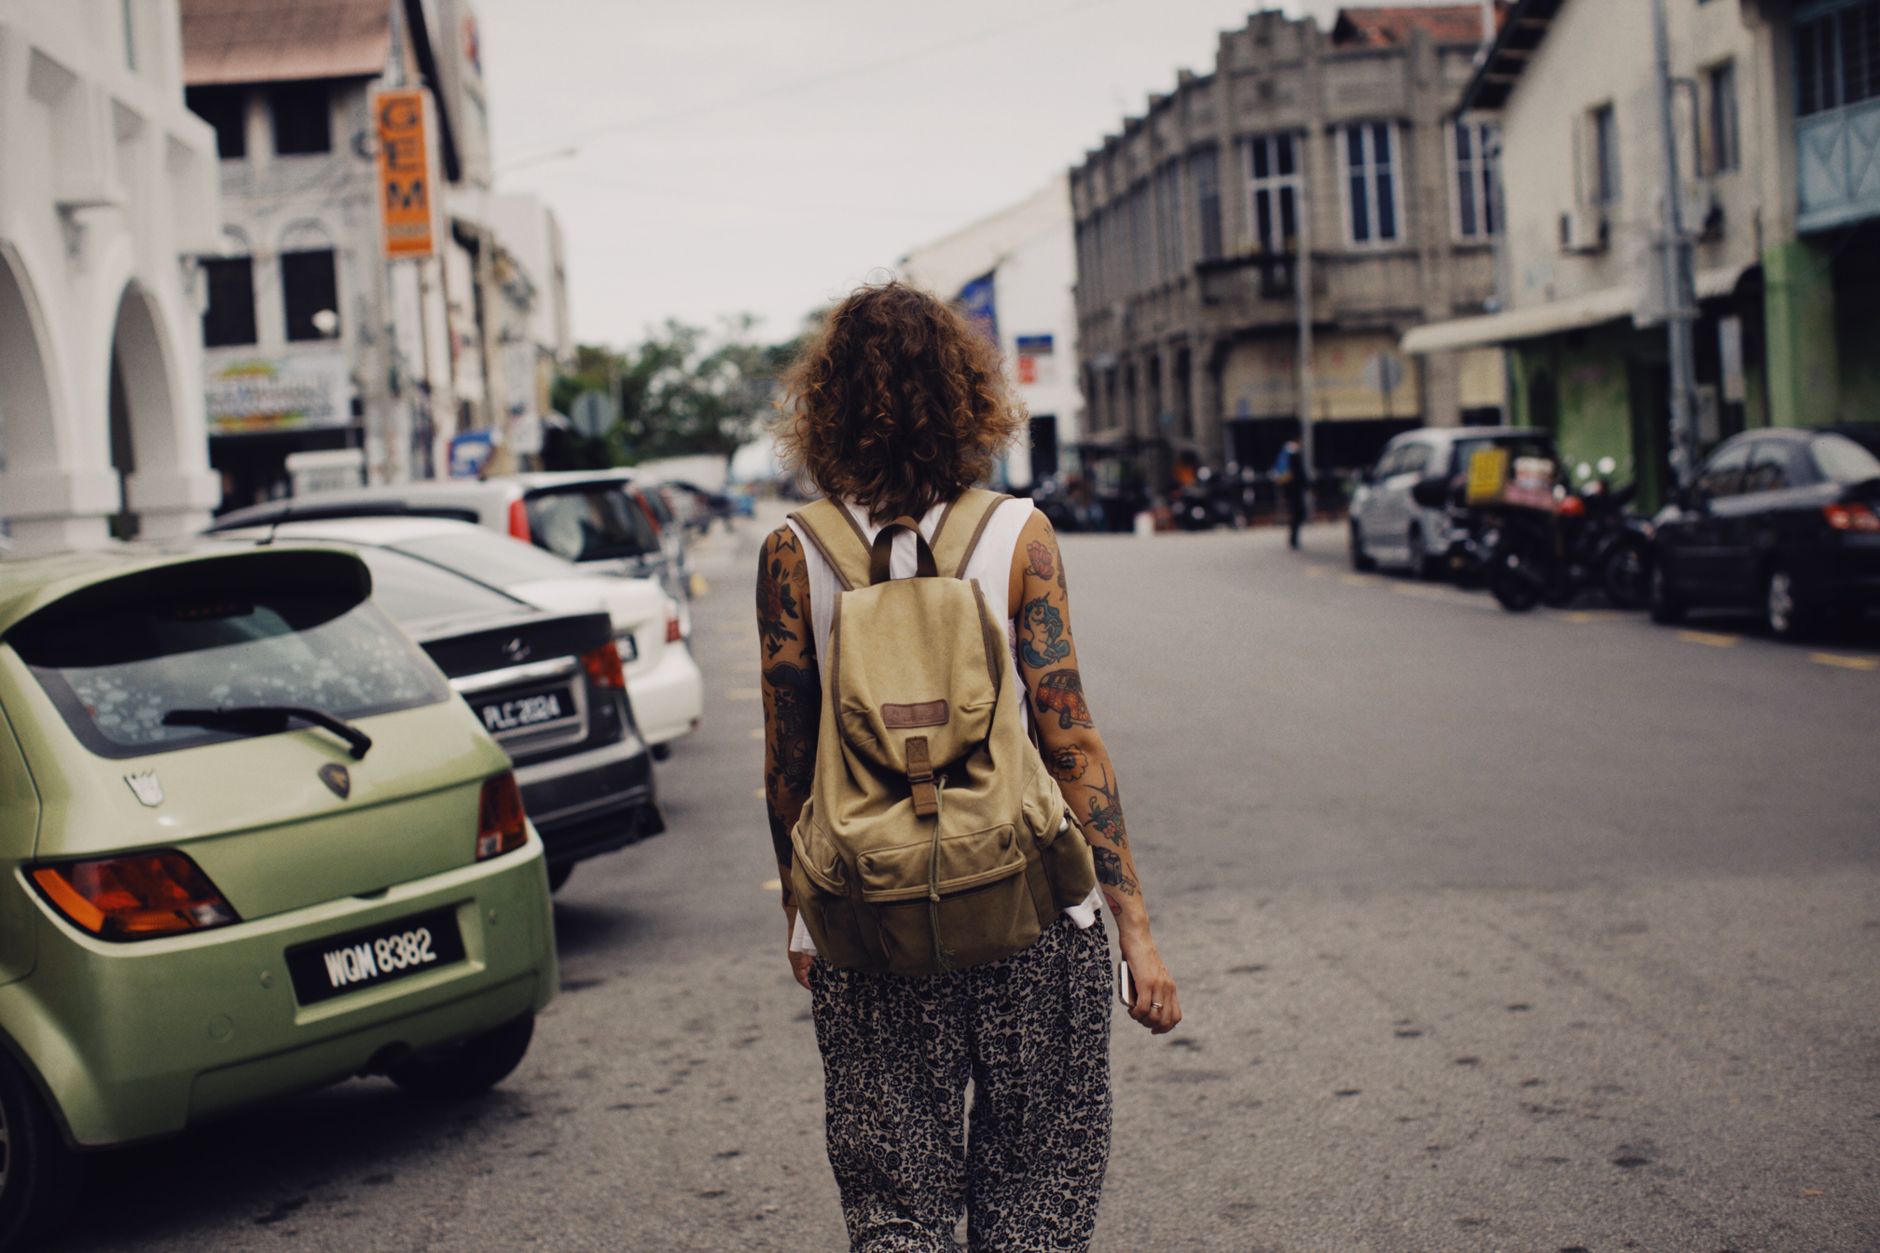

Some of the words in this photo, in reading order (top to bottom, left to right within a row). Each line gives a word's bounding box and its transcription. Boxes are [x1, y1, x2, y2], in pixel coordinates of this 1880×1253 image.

[382, 98, 426, 209] GEM
[482, 702, 518, 730] PLC
[324, 942, 378, 988] WQM
[374, 927, 437, 973] 8382
